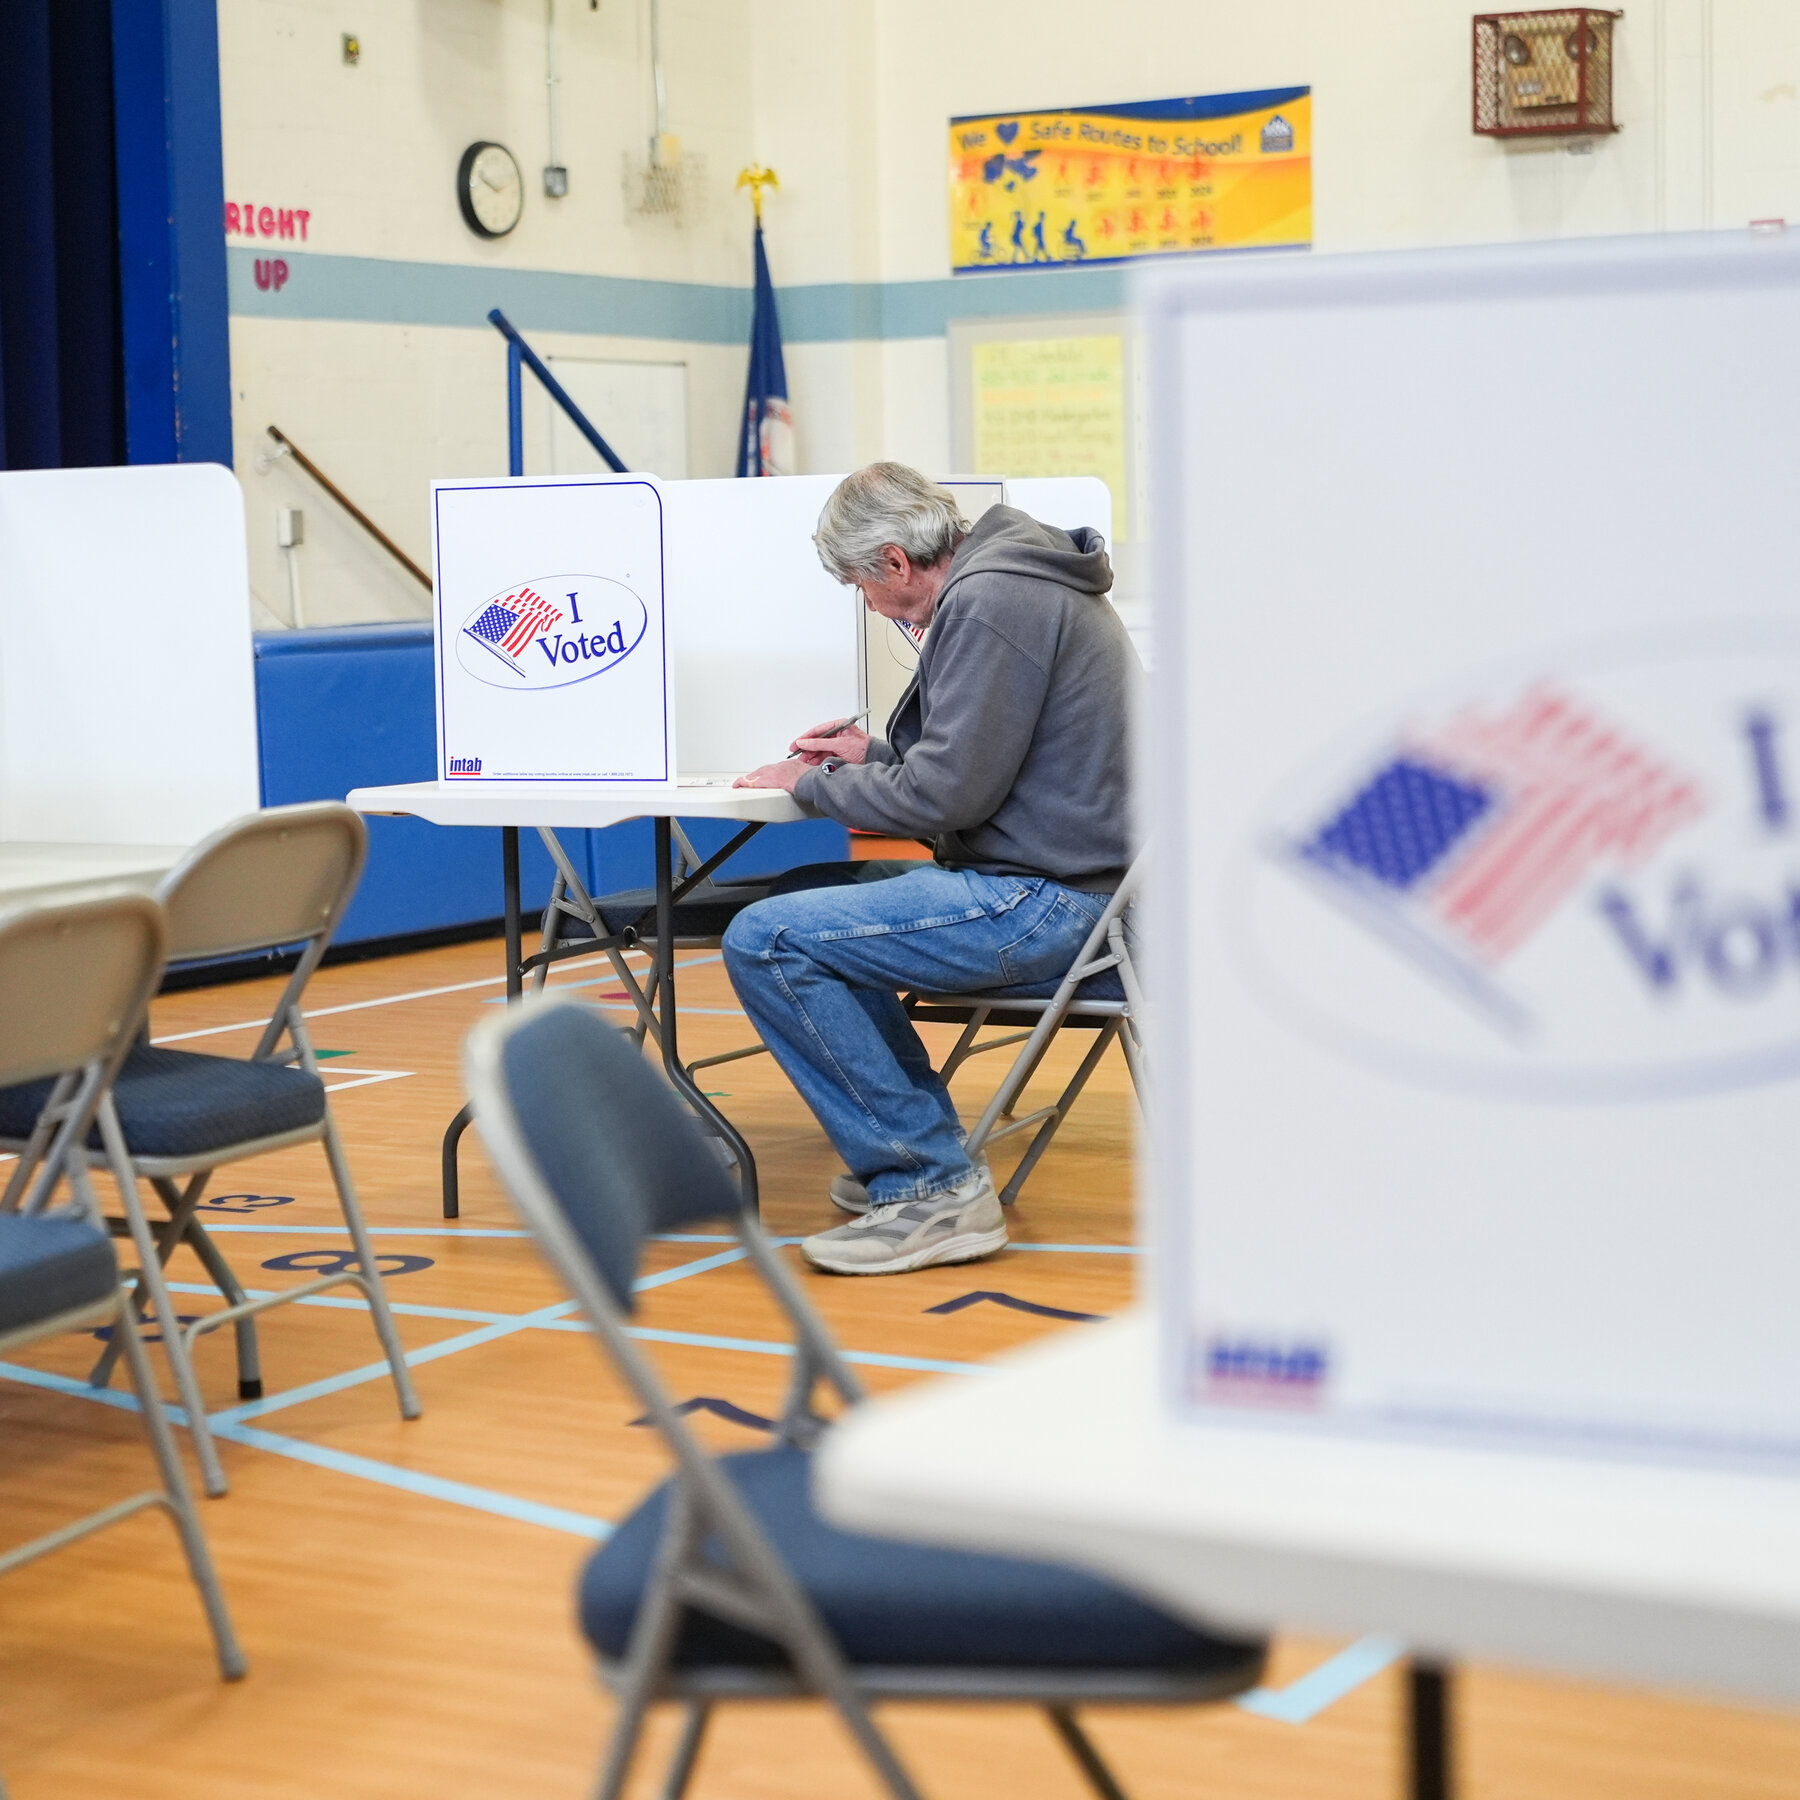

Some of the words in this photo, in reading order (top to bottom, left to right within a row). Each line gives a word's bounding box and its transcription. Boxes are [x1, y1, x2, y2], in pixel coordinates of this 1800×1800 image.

[1030, 120, 1073, 141] Safe
[1079, 122, 1142, 151] Routes
[1147, 134, 1169, 153] to
[1173, 133, 1243, 156] School!
[225, 202, 311, 241] RIGHT
[254, 259, 290, 292] UP
[566, 592, 583, 624] I
[536, 620, 628, 667] Voted
[450, 756, 482, 772] intab
